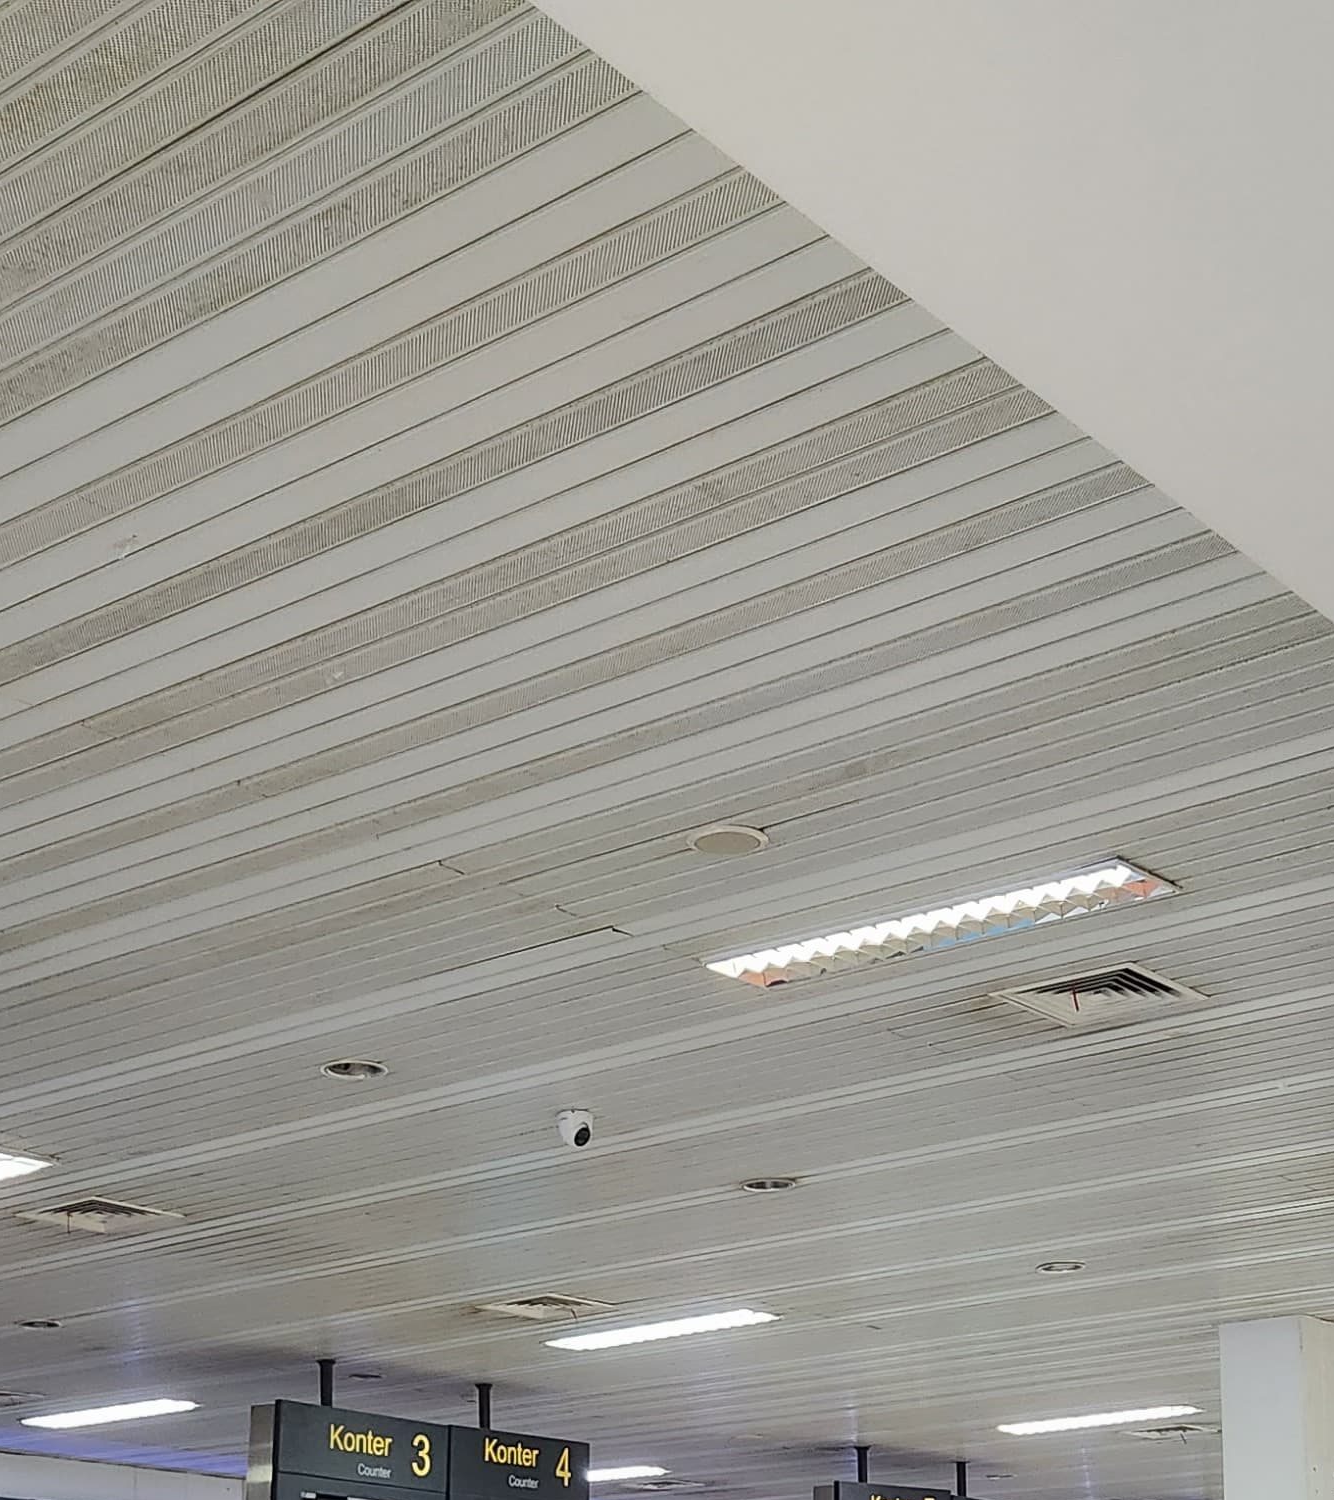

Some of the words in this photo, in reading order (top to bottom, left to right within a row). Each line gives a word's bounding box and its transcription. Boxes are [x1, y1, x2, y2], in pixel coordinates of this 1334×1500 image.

[329, 1424, 393, 1457] Konter
[411, 1434, 431, 1477] 3
[484, 1437, 539, 1467] Konter
[555, 1447, 572, 1487] 4
[357, 1463, 392, 1479] Counter
[508, 1475, 539, 1489] Counter
